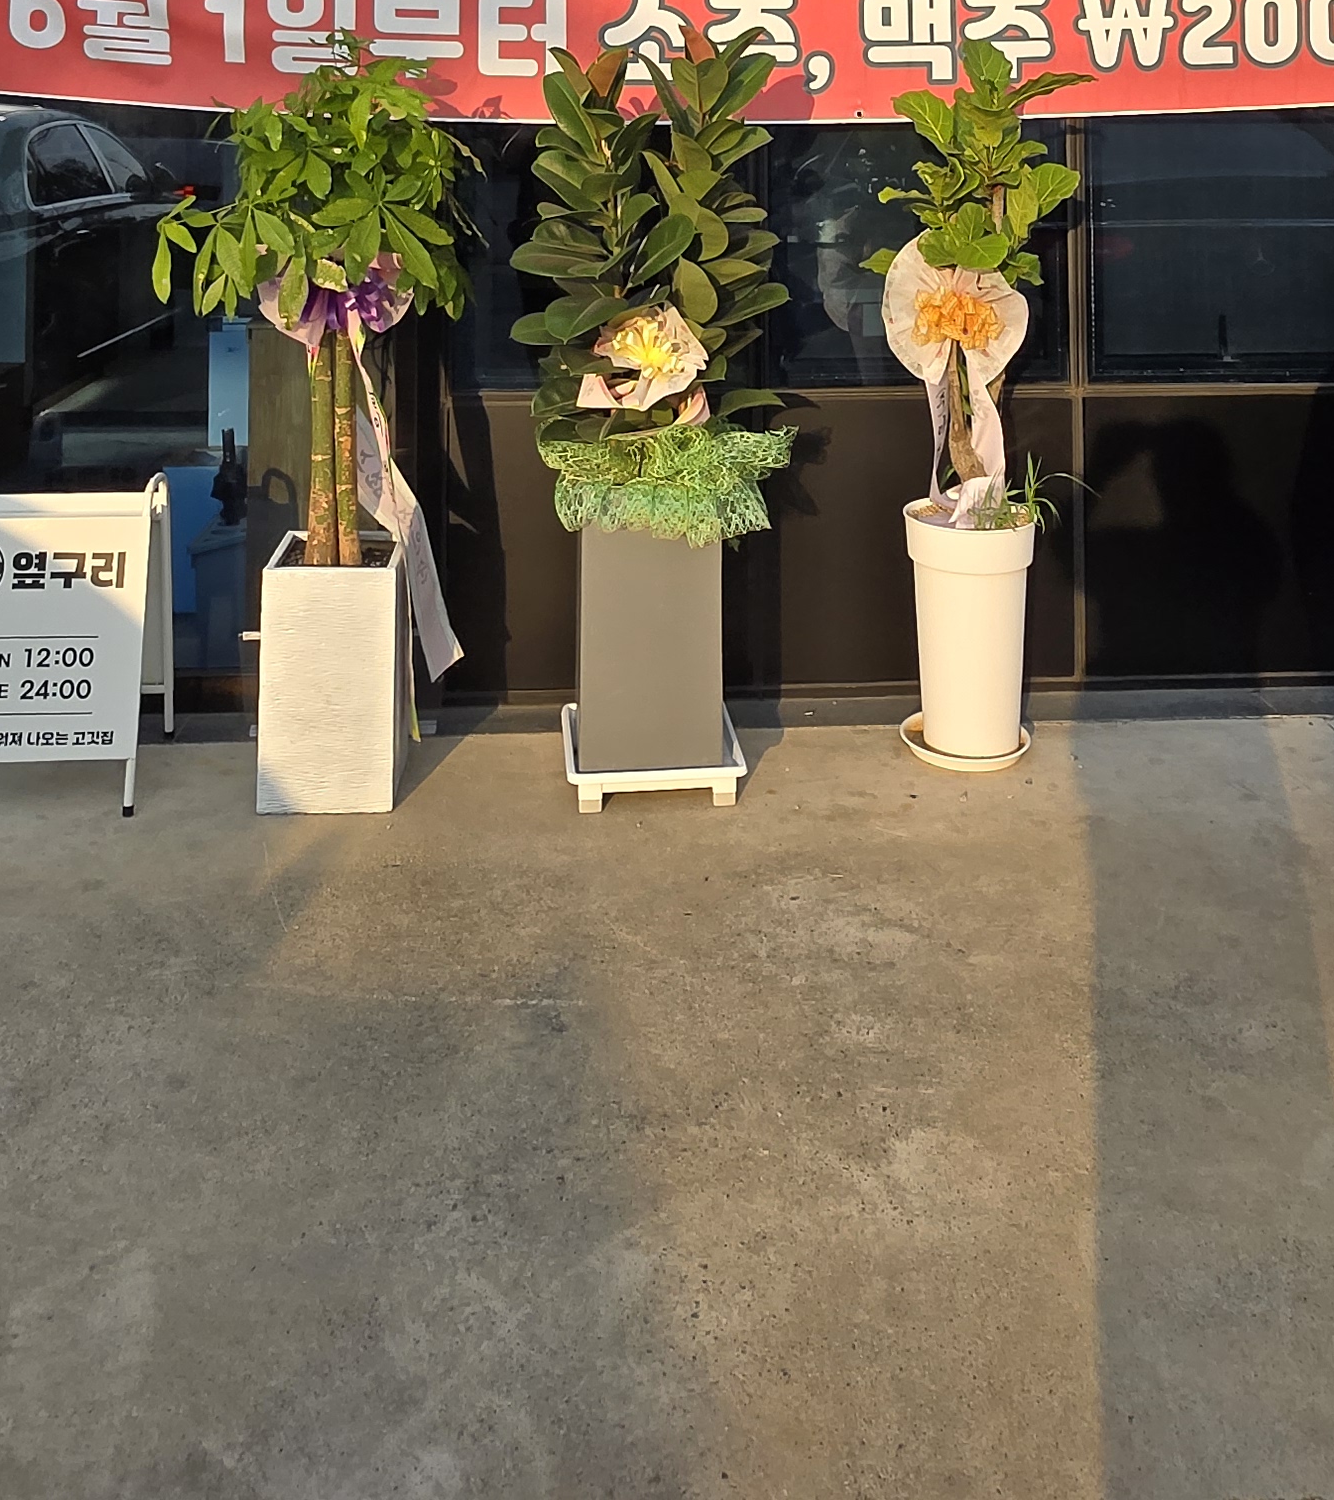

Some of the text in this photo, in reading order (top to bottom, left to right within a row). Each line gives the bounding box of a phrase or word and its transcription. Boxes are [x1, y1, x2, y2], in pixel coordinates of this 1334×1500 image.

[11, 551, 127, 590] 옆구리
[23, 647, 95, 668] 12:00
[20, 679, 92, 700] 24:00
[27, 731, 69, 746] 나오는
[72, 730, 114, 746] 고깃집
